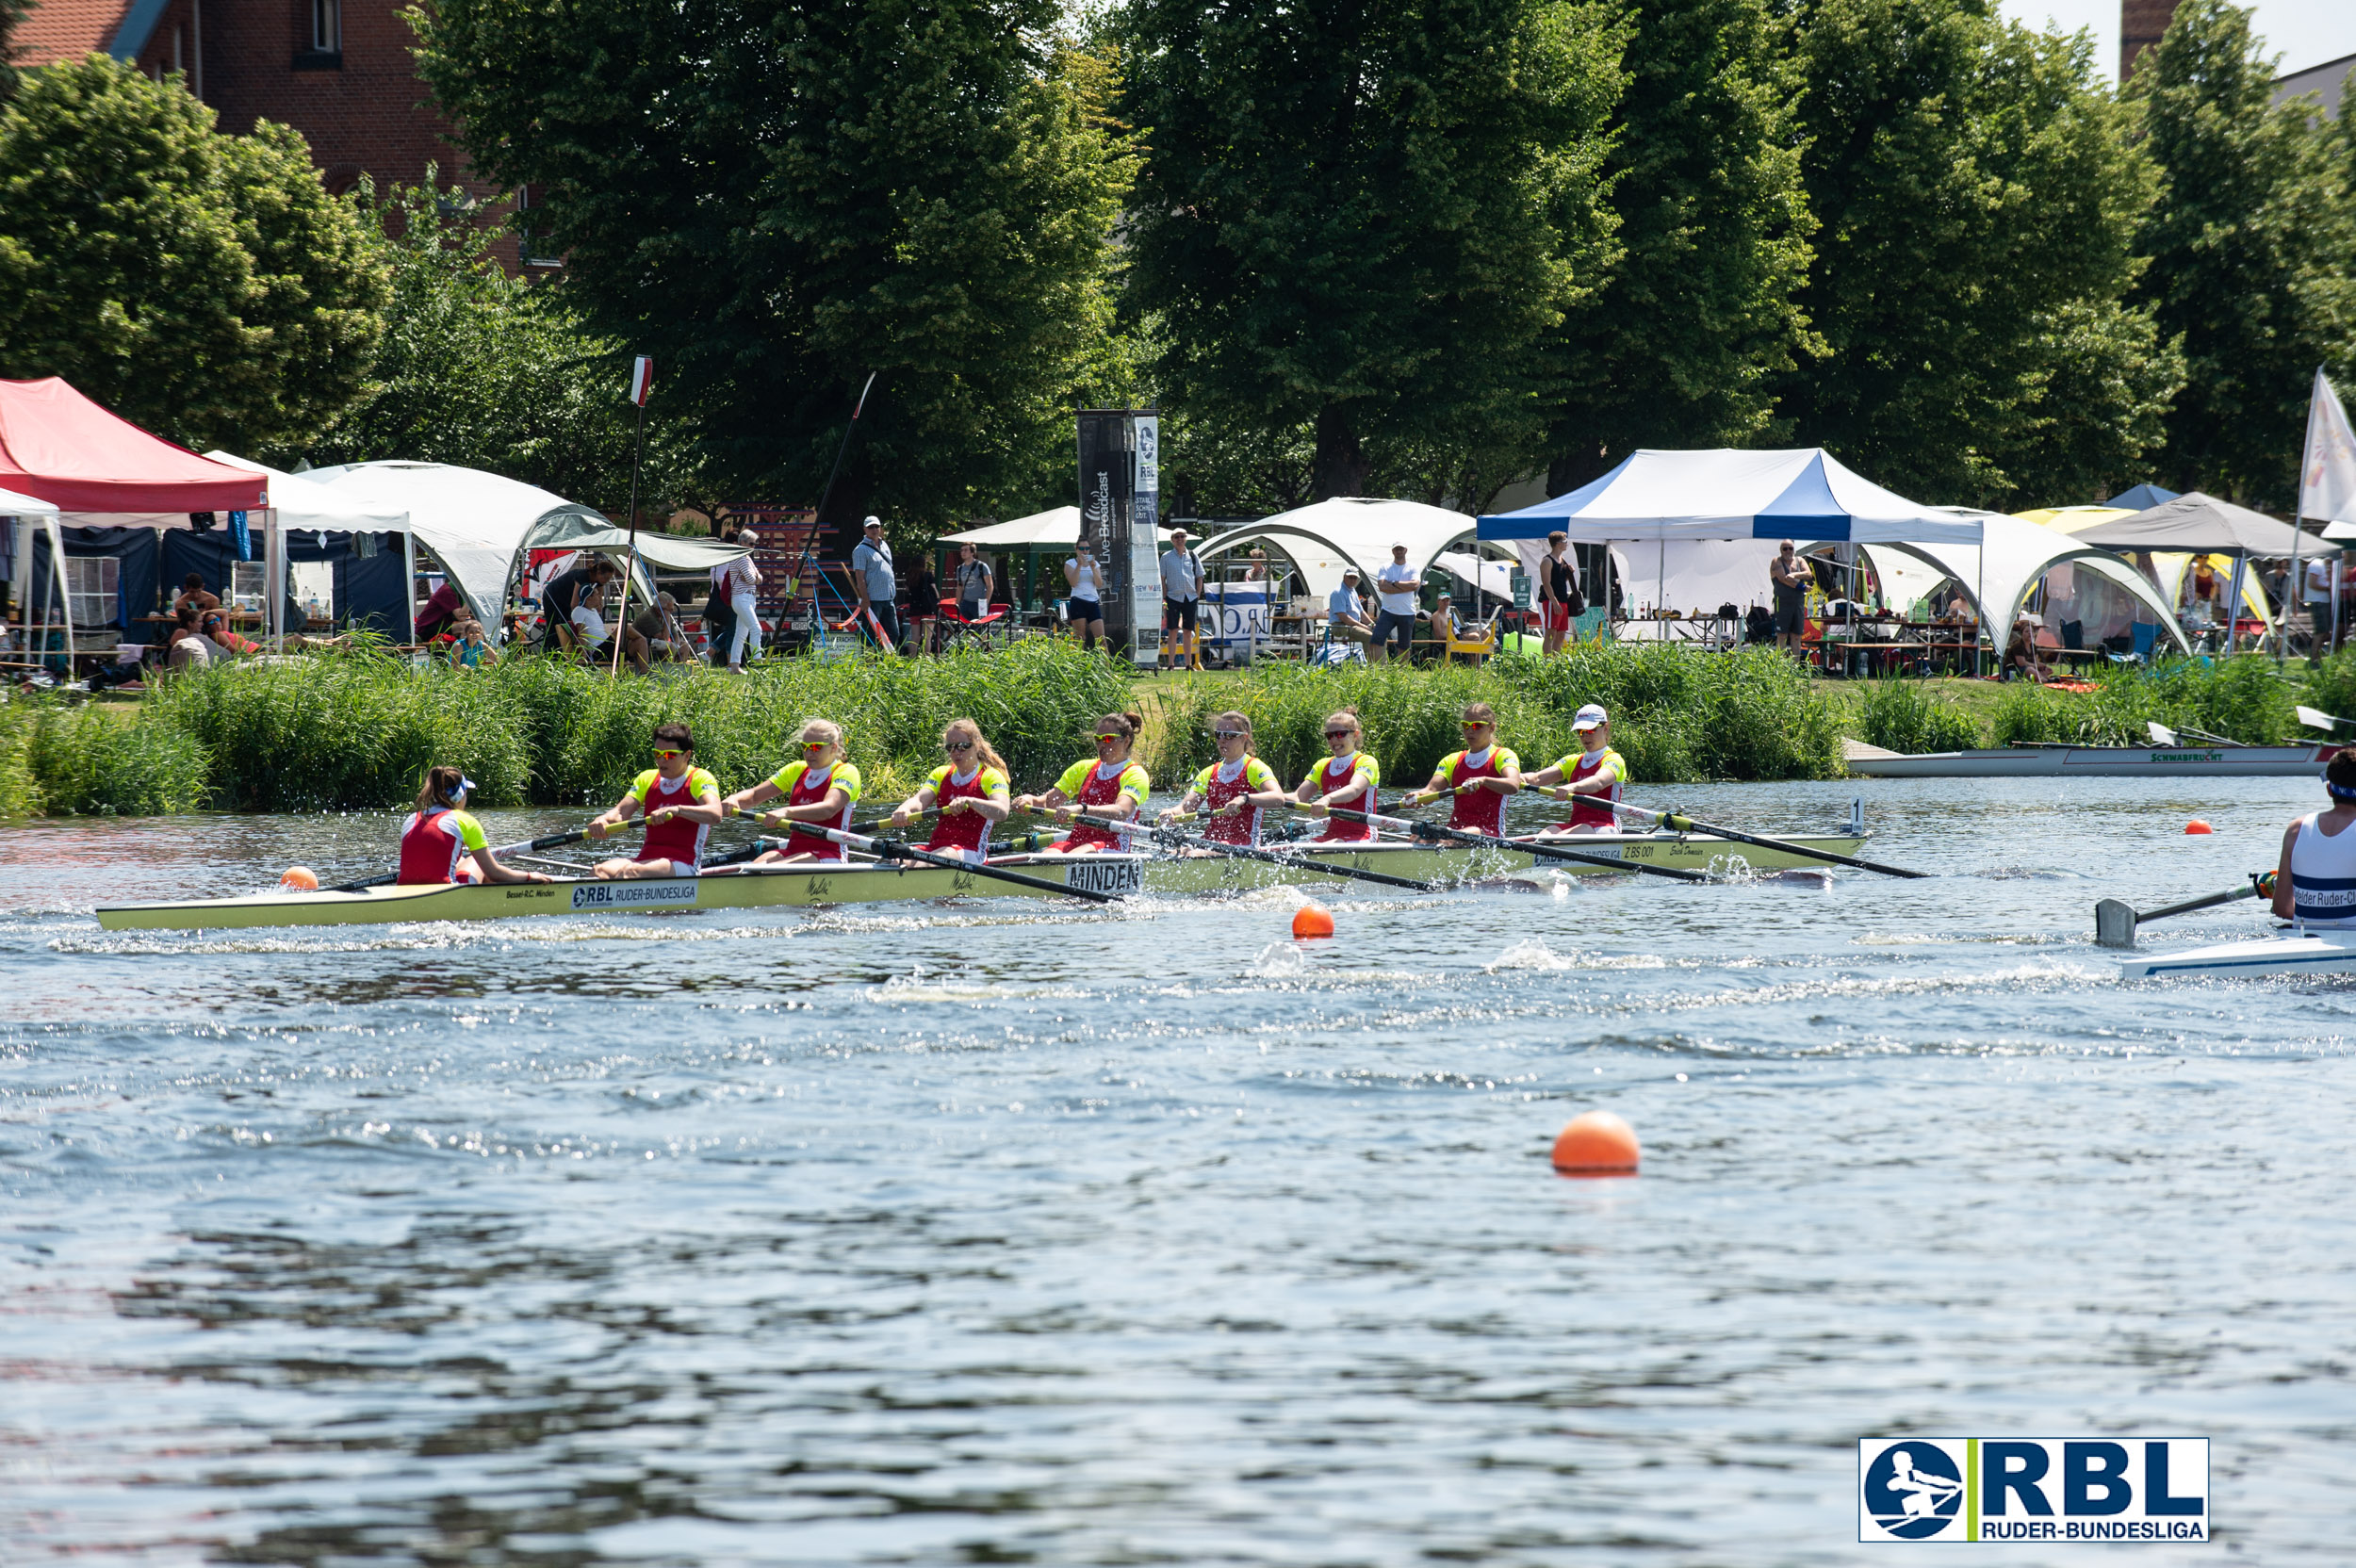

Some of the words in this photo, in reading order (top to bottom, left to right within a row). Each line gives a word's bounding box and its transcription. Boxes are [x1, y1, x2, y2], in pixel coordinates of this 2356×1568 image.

[1140, 466, 1154, 478] RBL
[1097, 471, 1109, 537] Broadcast
[1100, 540, 1110, 564] Live
[1853, 798, 1859, 823] 1
[1624, 846, 1630, 858] Z
[1630, 846, 1641, 858] BS
[1642, 845, 1654, 858] 001
[1069, 864, 1140, 891] MINDEN
[535, 890, 555, 898] Minden
[587, 886, 614, 903] RBL
[615, 885, 695, 902] RUDER-BUNDESLIGA
